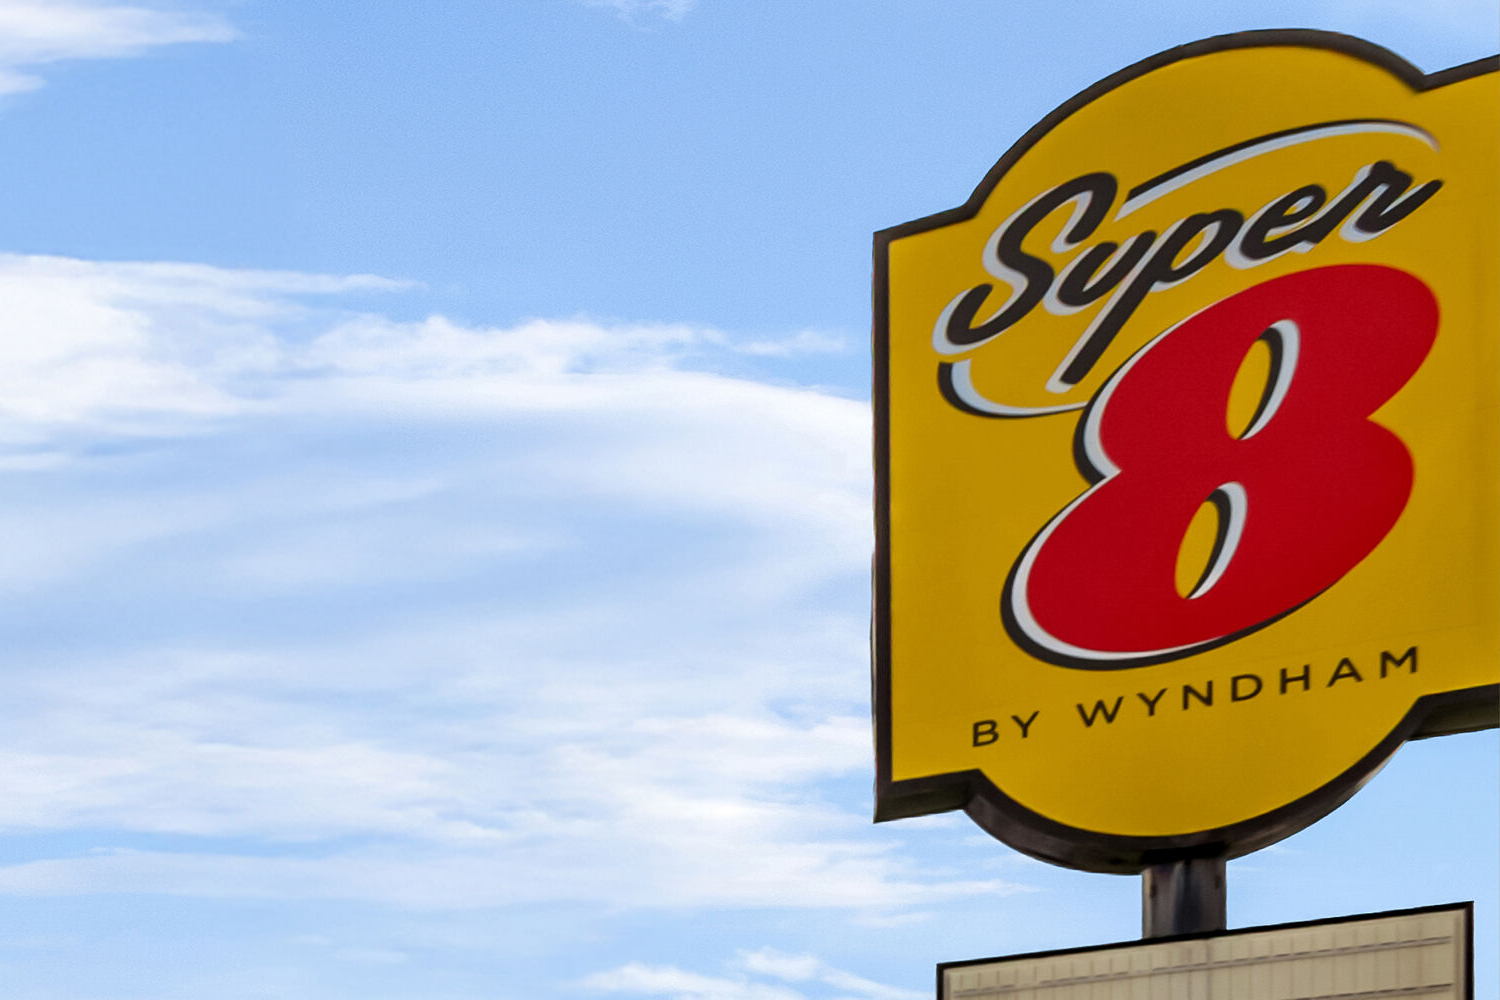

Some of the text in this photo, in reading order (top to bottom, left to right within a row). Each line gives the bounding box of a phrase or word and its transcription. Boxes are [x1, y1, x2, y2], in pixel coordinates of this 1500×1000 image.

[938, 160, 1444, 389] Super
[1003, 263, 1441, 669] 8
[971, 646, 1419, 748] BY WYNDHAM
